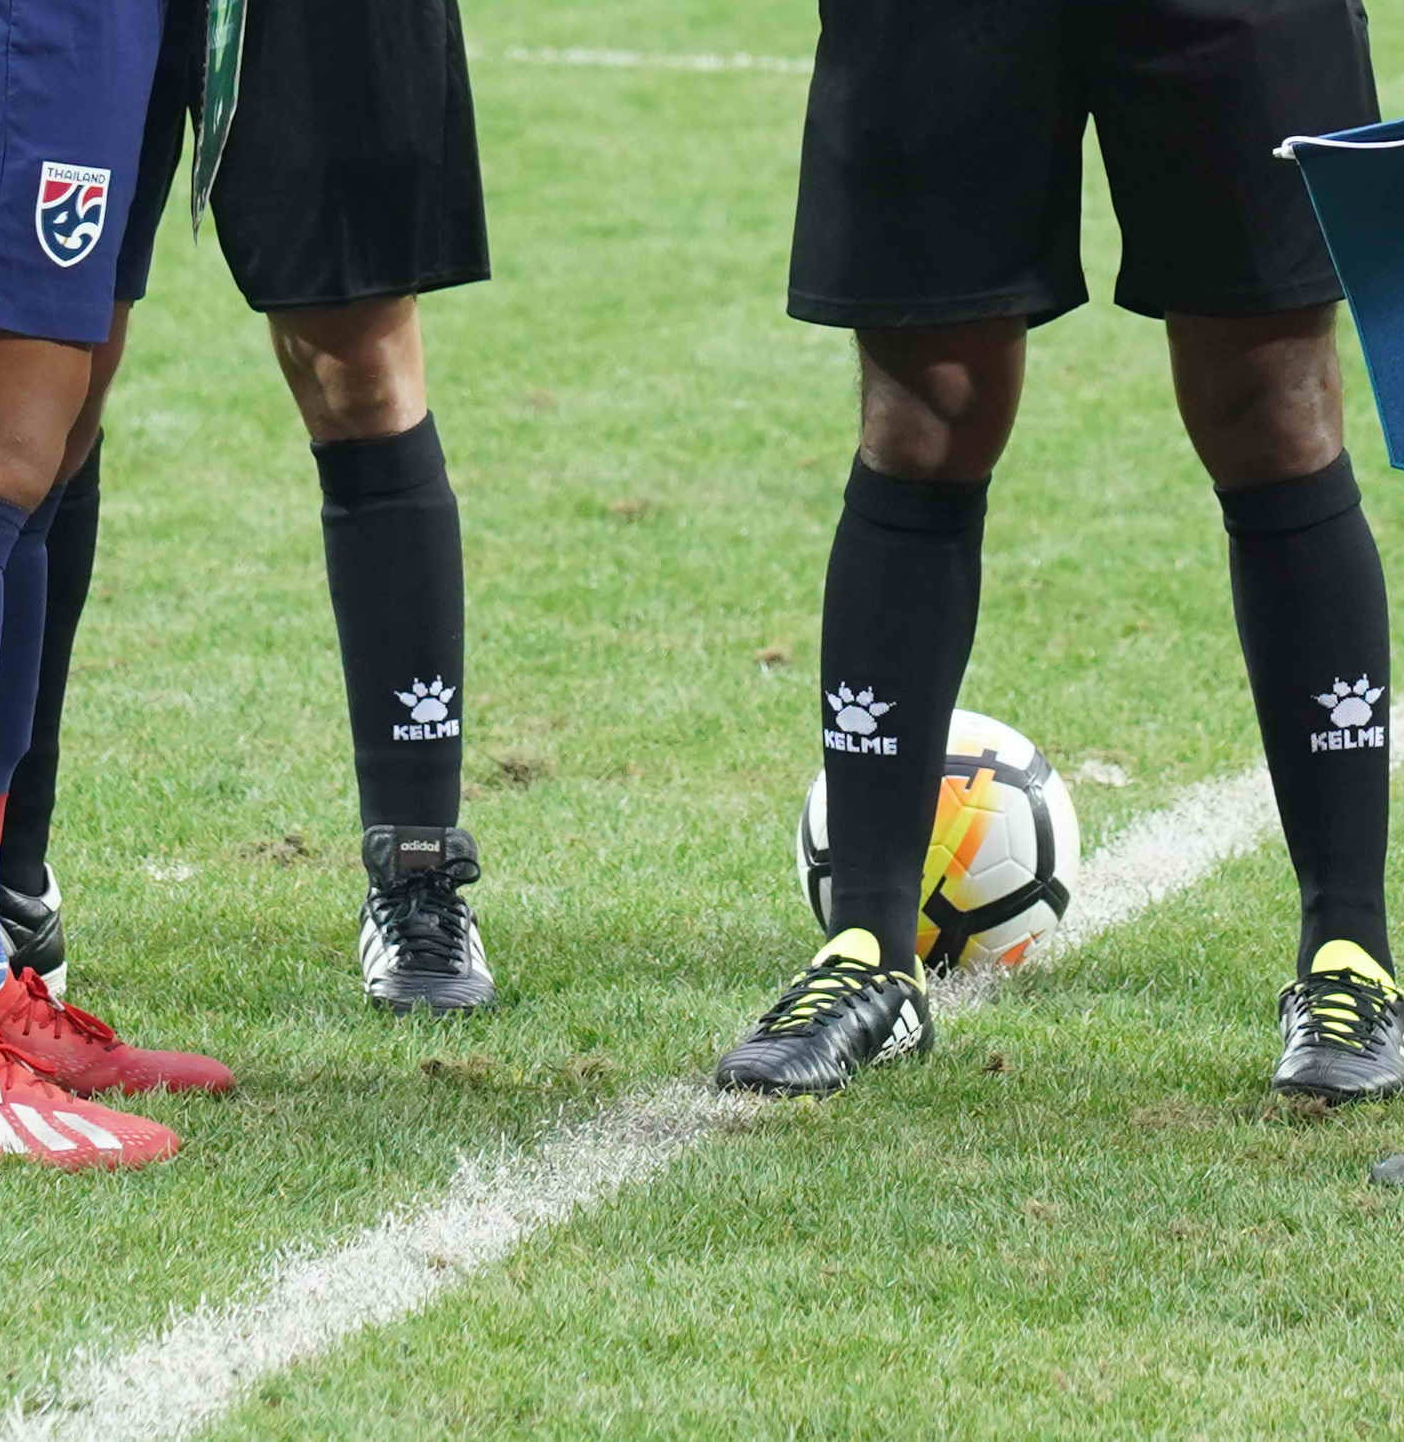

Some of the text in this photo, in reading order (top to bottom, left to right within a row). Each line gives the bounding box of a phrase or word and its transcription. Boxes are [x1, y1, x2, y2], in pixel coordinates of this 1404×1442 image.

[47, 167, 106, 184] THAILAND
[393, 719, 460, 741] KELME
[1310, 726, 1384, 753] KELME
[824, 728, 897, 755] KELME
[400, 839, 440, 852] adidas
